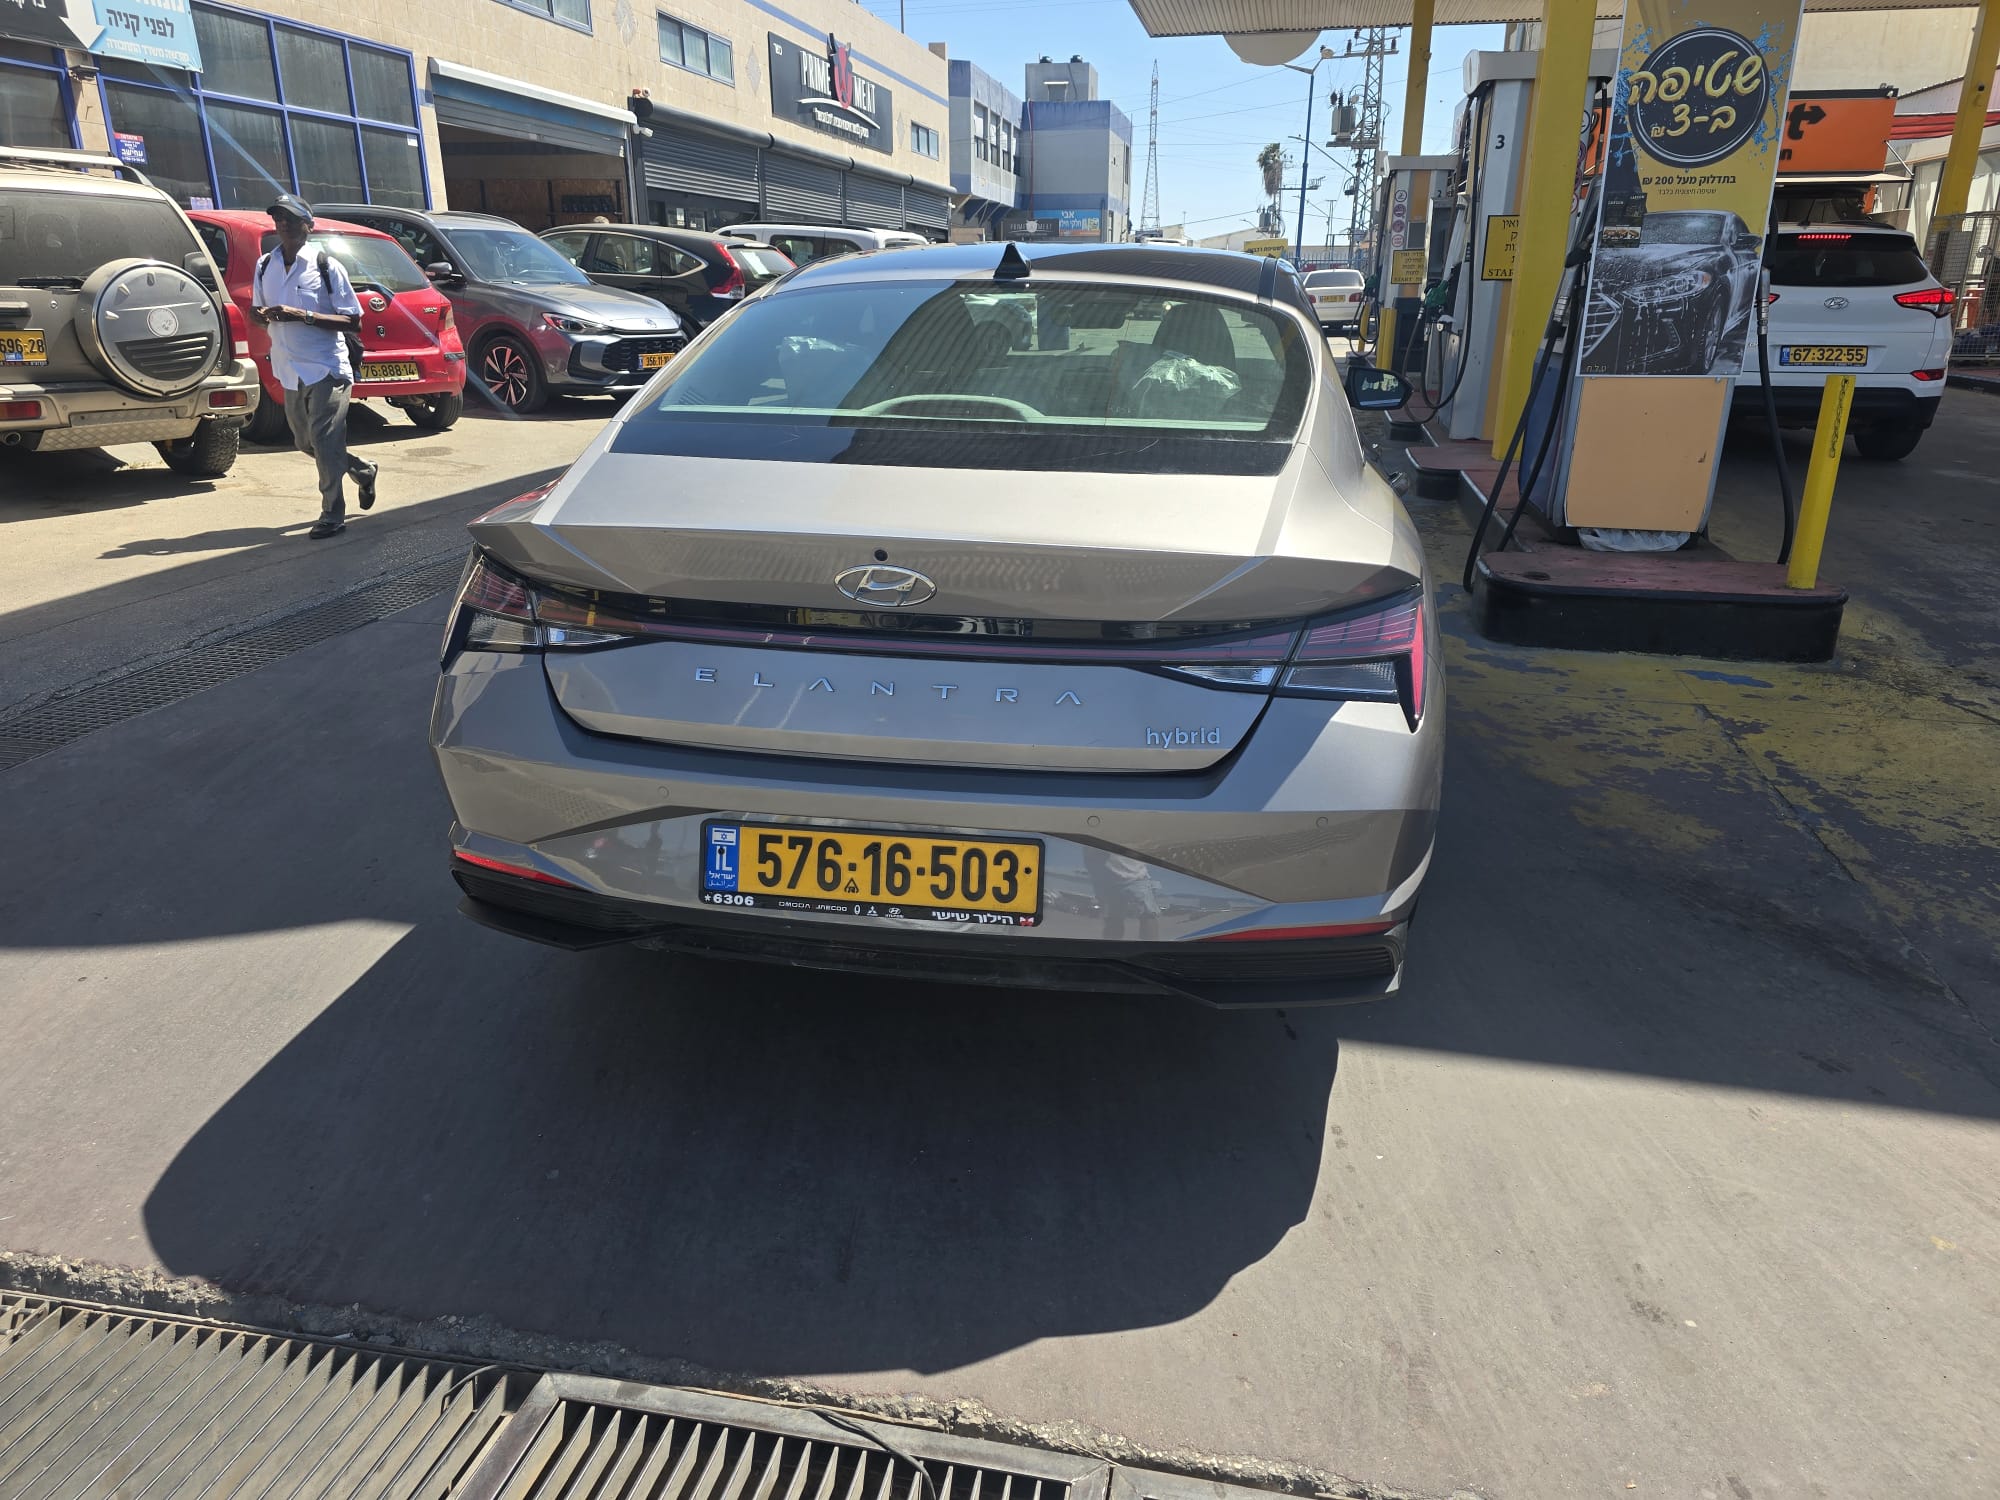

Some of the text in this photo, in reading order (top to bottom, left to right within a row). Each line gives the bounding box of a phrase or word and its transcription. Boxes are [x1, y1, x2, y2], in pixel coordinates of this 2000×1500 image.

[106, 8, 175, 38] לפני קניה
[799, 50, 876, 115] PRIME MEAT
[1627, 51, 1763, 106] שטיפה
[1495, 134, 1506, 149] 3
[1655, 175, 1675, 186] 200
[1676, 174, 1697, 185] מעל
[1699, 174, 1737, 187] בתדלוק
[694, 667, 1082, 706] ELANTRA
[1145, 727, 1221, 749] hybrid
[715, 845, 733, 871] IL
[708, 870, 736, 880] ישראל
[815, 904, 848, 912] JAECOO
[931, 910, 971, 922] שישי
